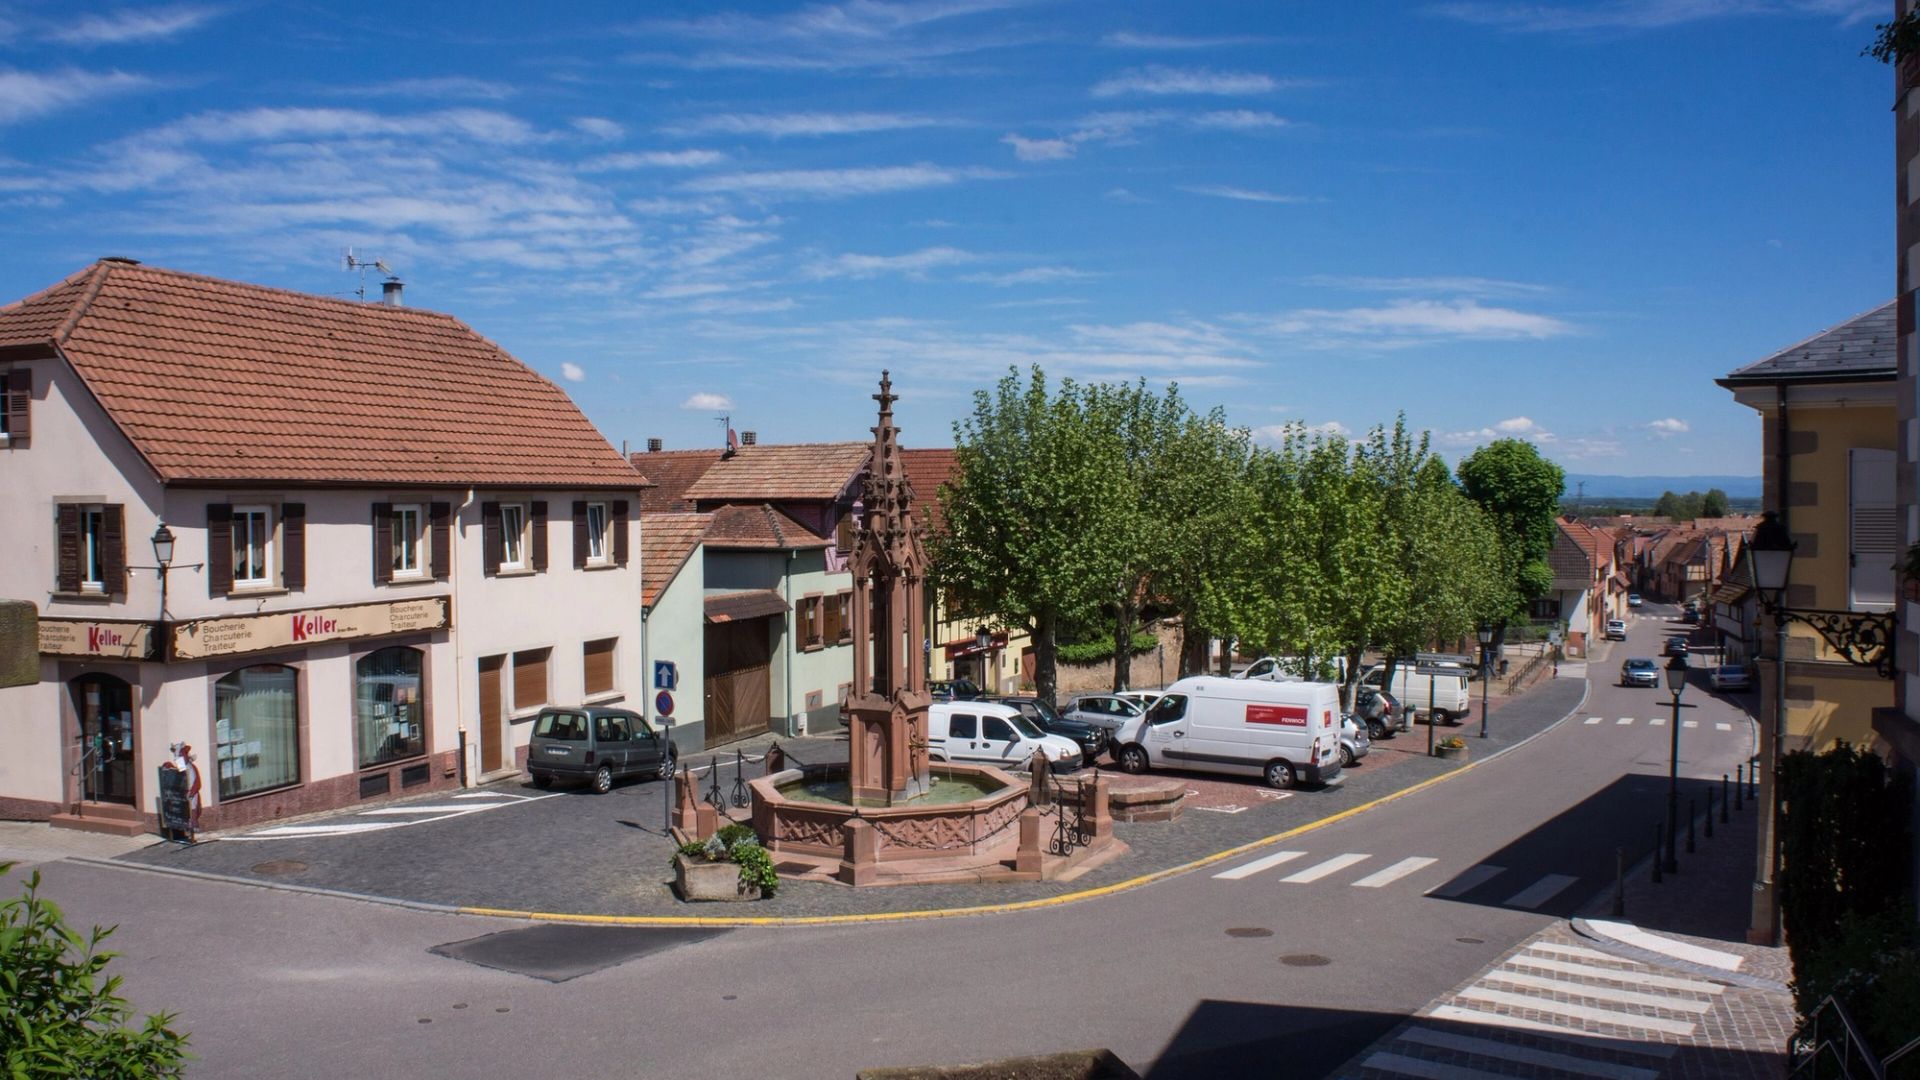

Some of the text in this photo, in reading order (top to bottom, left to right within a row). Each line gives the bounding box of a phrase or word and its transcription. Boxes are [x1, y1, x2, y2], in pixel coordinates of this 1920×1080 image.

[390, 605, 423, 614] Boucherie
[389, 612, 429, 622] Charcuterie
[39, 626, 70, 634] oucherie
[203, 623, 246, 634] Boucherie
[292, 615, 337, 641] Keller
[390, 621, 417, 630] Traiteur
[88, 626, 122, 652] Keller
[203, 631, 252, 643] Charcuterie
[203, 642, 236, 652] Traiteur
